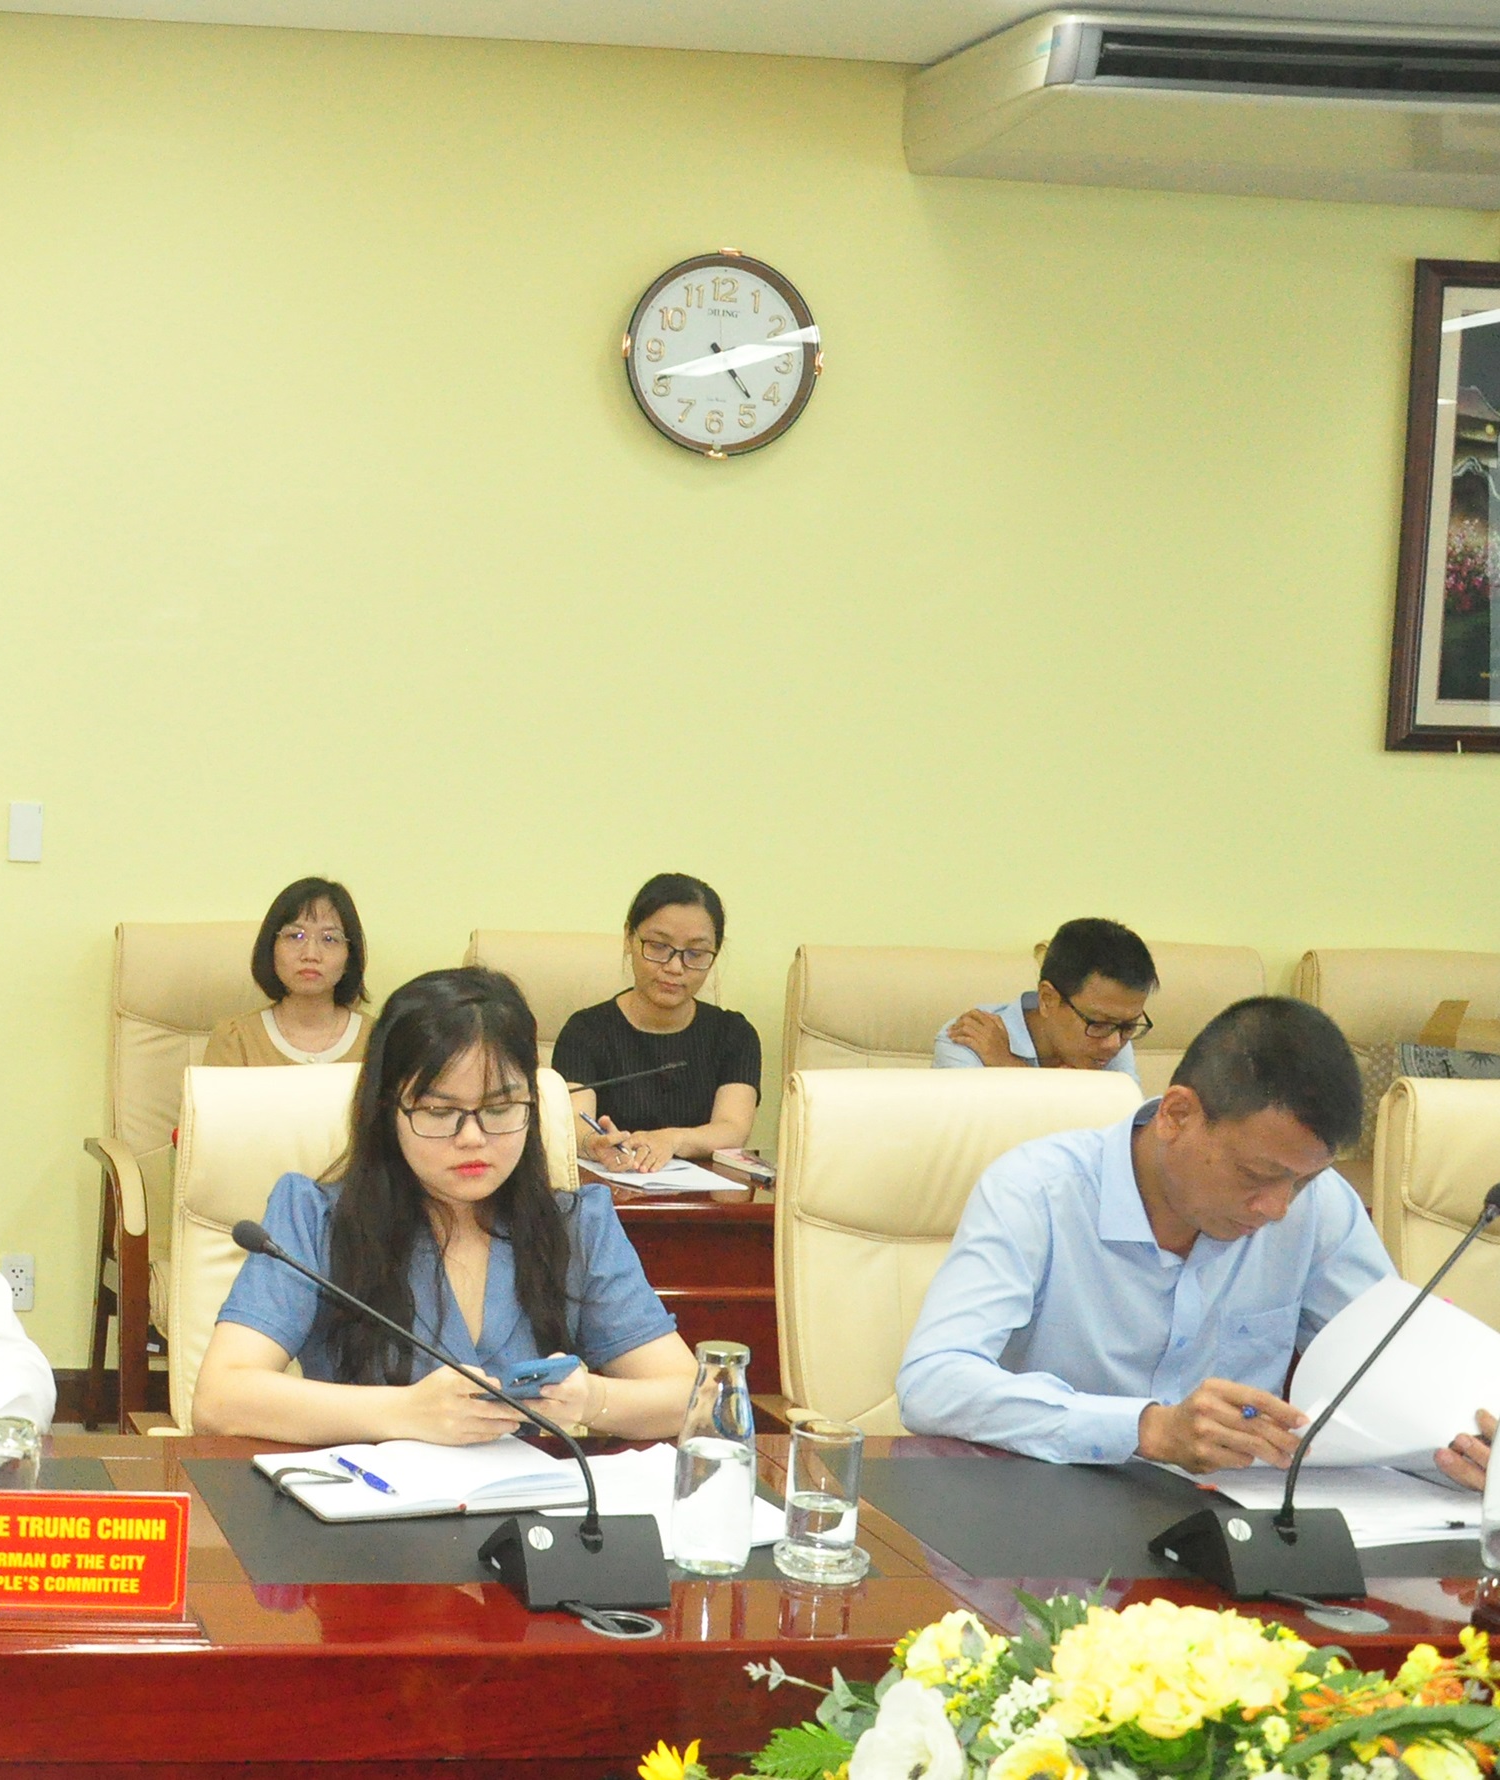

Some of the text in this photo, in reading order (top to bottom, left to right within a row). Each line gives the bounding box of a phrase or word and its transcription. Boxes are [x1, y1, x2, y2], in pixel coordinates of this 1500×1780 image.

[684, 283, 705, 309] 11
[711, 276, 739, 303] 12
[751, 289, 761, 314] 1
[659, 306, 687, 332] 10
[766, 314, 786, 340] 2
[646, 337, 665, 362] 9
[774, 351, 794, 375] 3
[652, 373, 672, 397] 8
[762, 382, 781, 407] 4
[677, 398, 696, 423] 7
[705, 409, 725, 434] 6
[738, 403, 757, 428] 5
[16, 1515, 91, 1540] TRUNG
[96, 1517, 167, 1541] CHINH
[50, 1553, 72, 1569] OF
[74, 1553, 106, 1571] THE
[109, 1554, 146, 1571] CITY
[43, 1575, 140, 1594] COMMITTEE
